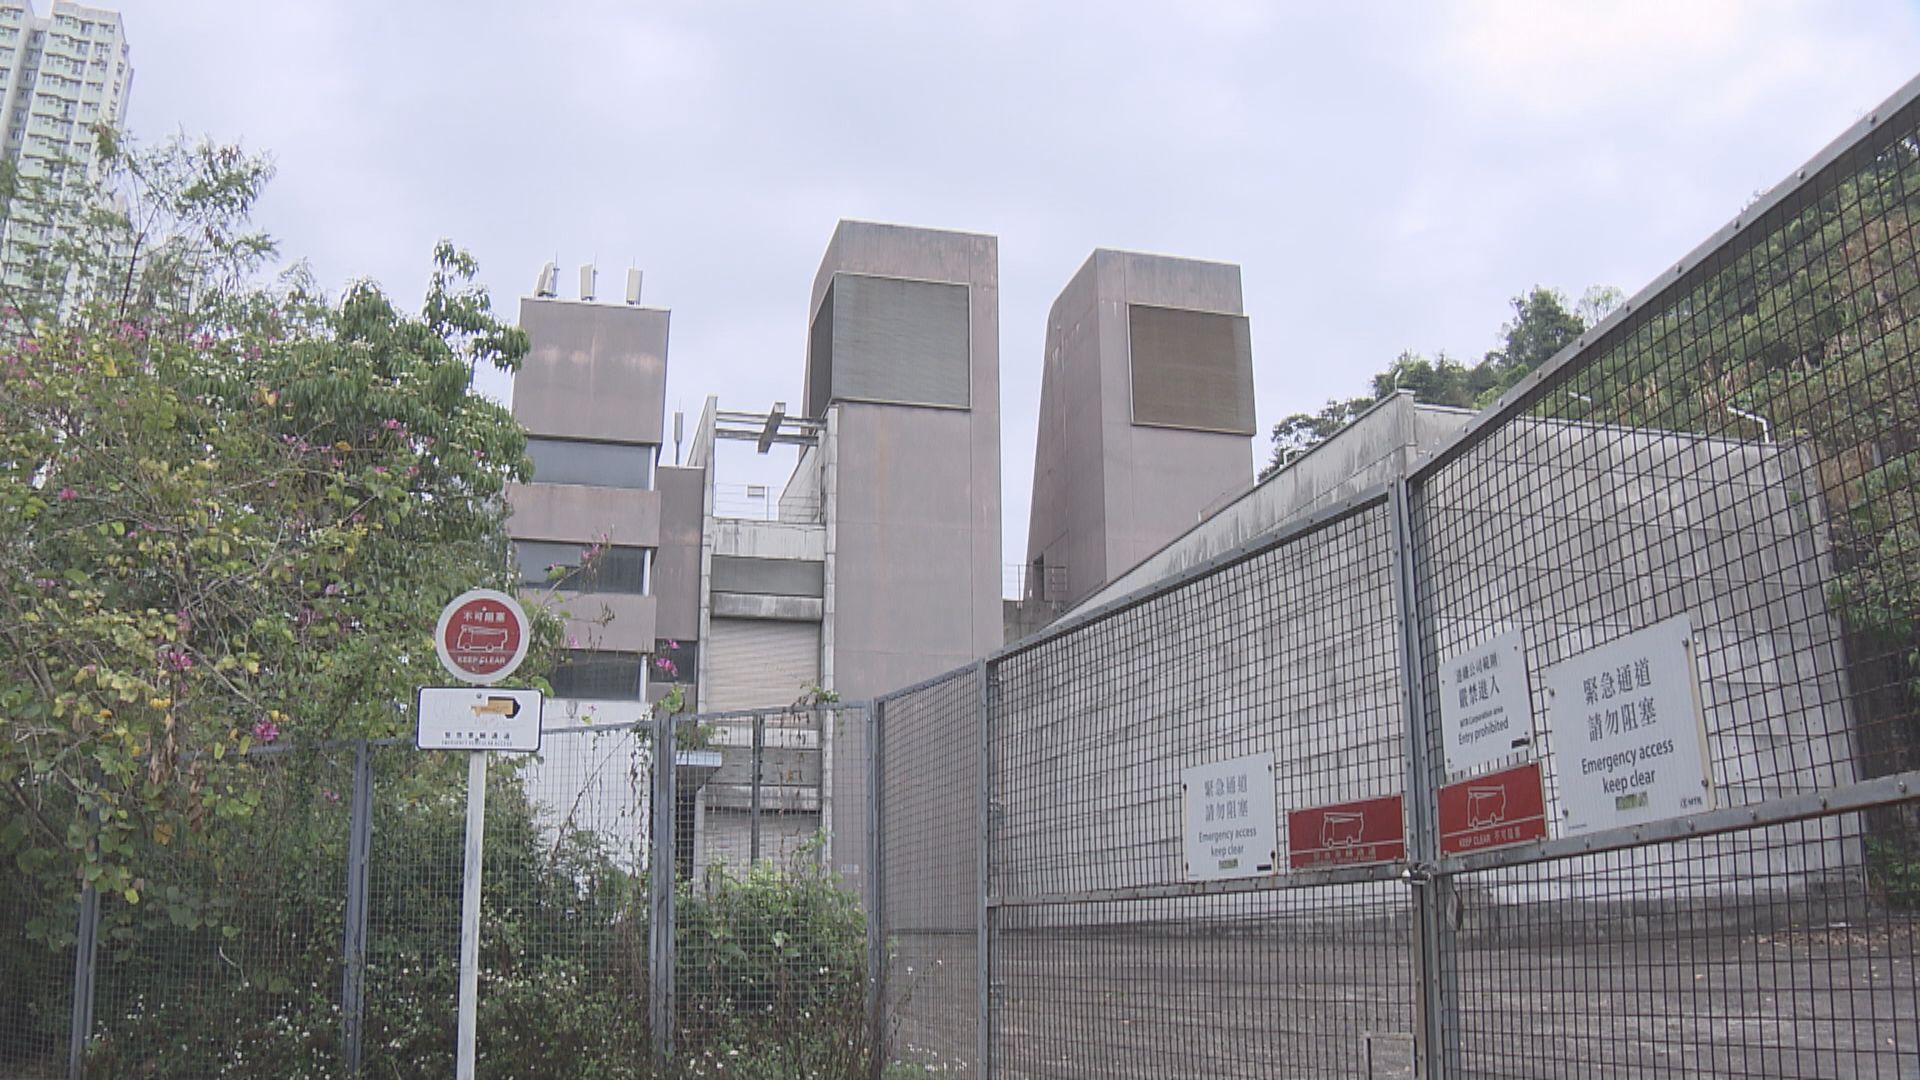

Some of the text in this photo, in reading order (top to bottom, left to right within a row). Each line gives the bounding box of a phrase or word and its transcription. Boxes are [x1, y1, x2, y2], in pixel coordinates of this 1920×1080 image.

[457, 656, 506, 664] KEEP CLEAR
[1583, 656, 1651, 706] 緊急通道
[1458, 715, 1509, 745] Entry prohibited
[1587, 696, 1656, 742] 請勿阻塞
[1581, 739, 1674, 775] Emergency access
[1204, 774, 1248, 798] 緊急通道
[1602, 769, 1656, 794] keep clear
[1205, 798, 1249, 822] 請勿阻塞
[1199, 827, 1257, 844] Emergency access
[1210, 843, 1244, 858] keep clear
